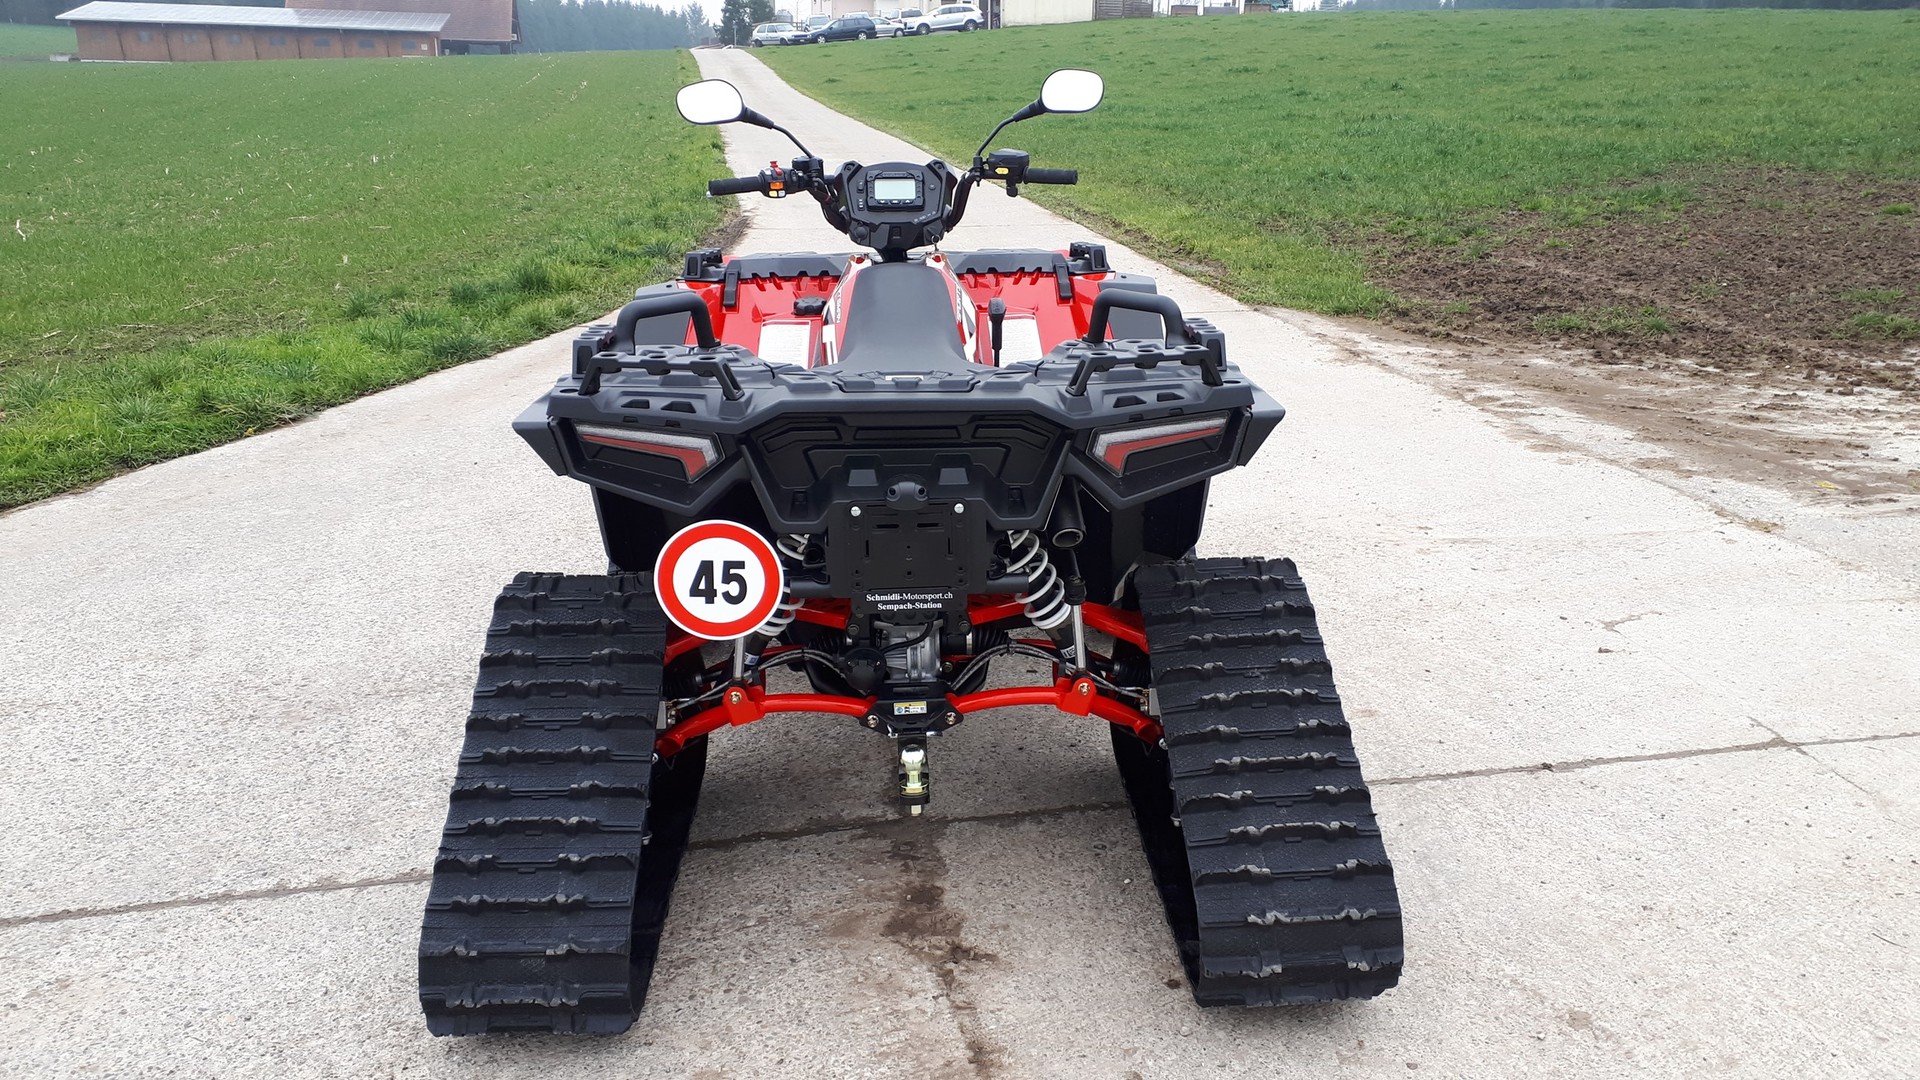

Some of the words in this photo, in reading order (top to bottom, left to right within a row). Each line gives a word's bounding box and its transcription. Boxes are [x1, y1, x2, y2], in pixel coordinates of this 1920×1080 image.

[689, 560, 748, 605] 45
[866, 592, 953, 601] Schmidli-Motorsport.ch
[877, 602, 942, 611] Sempach-Station
